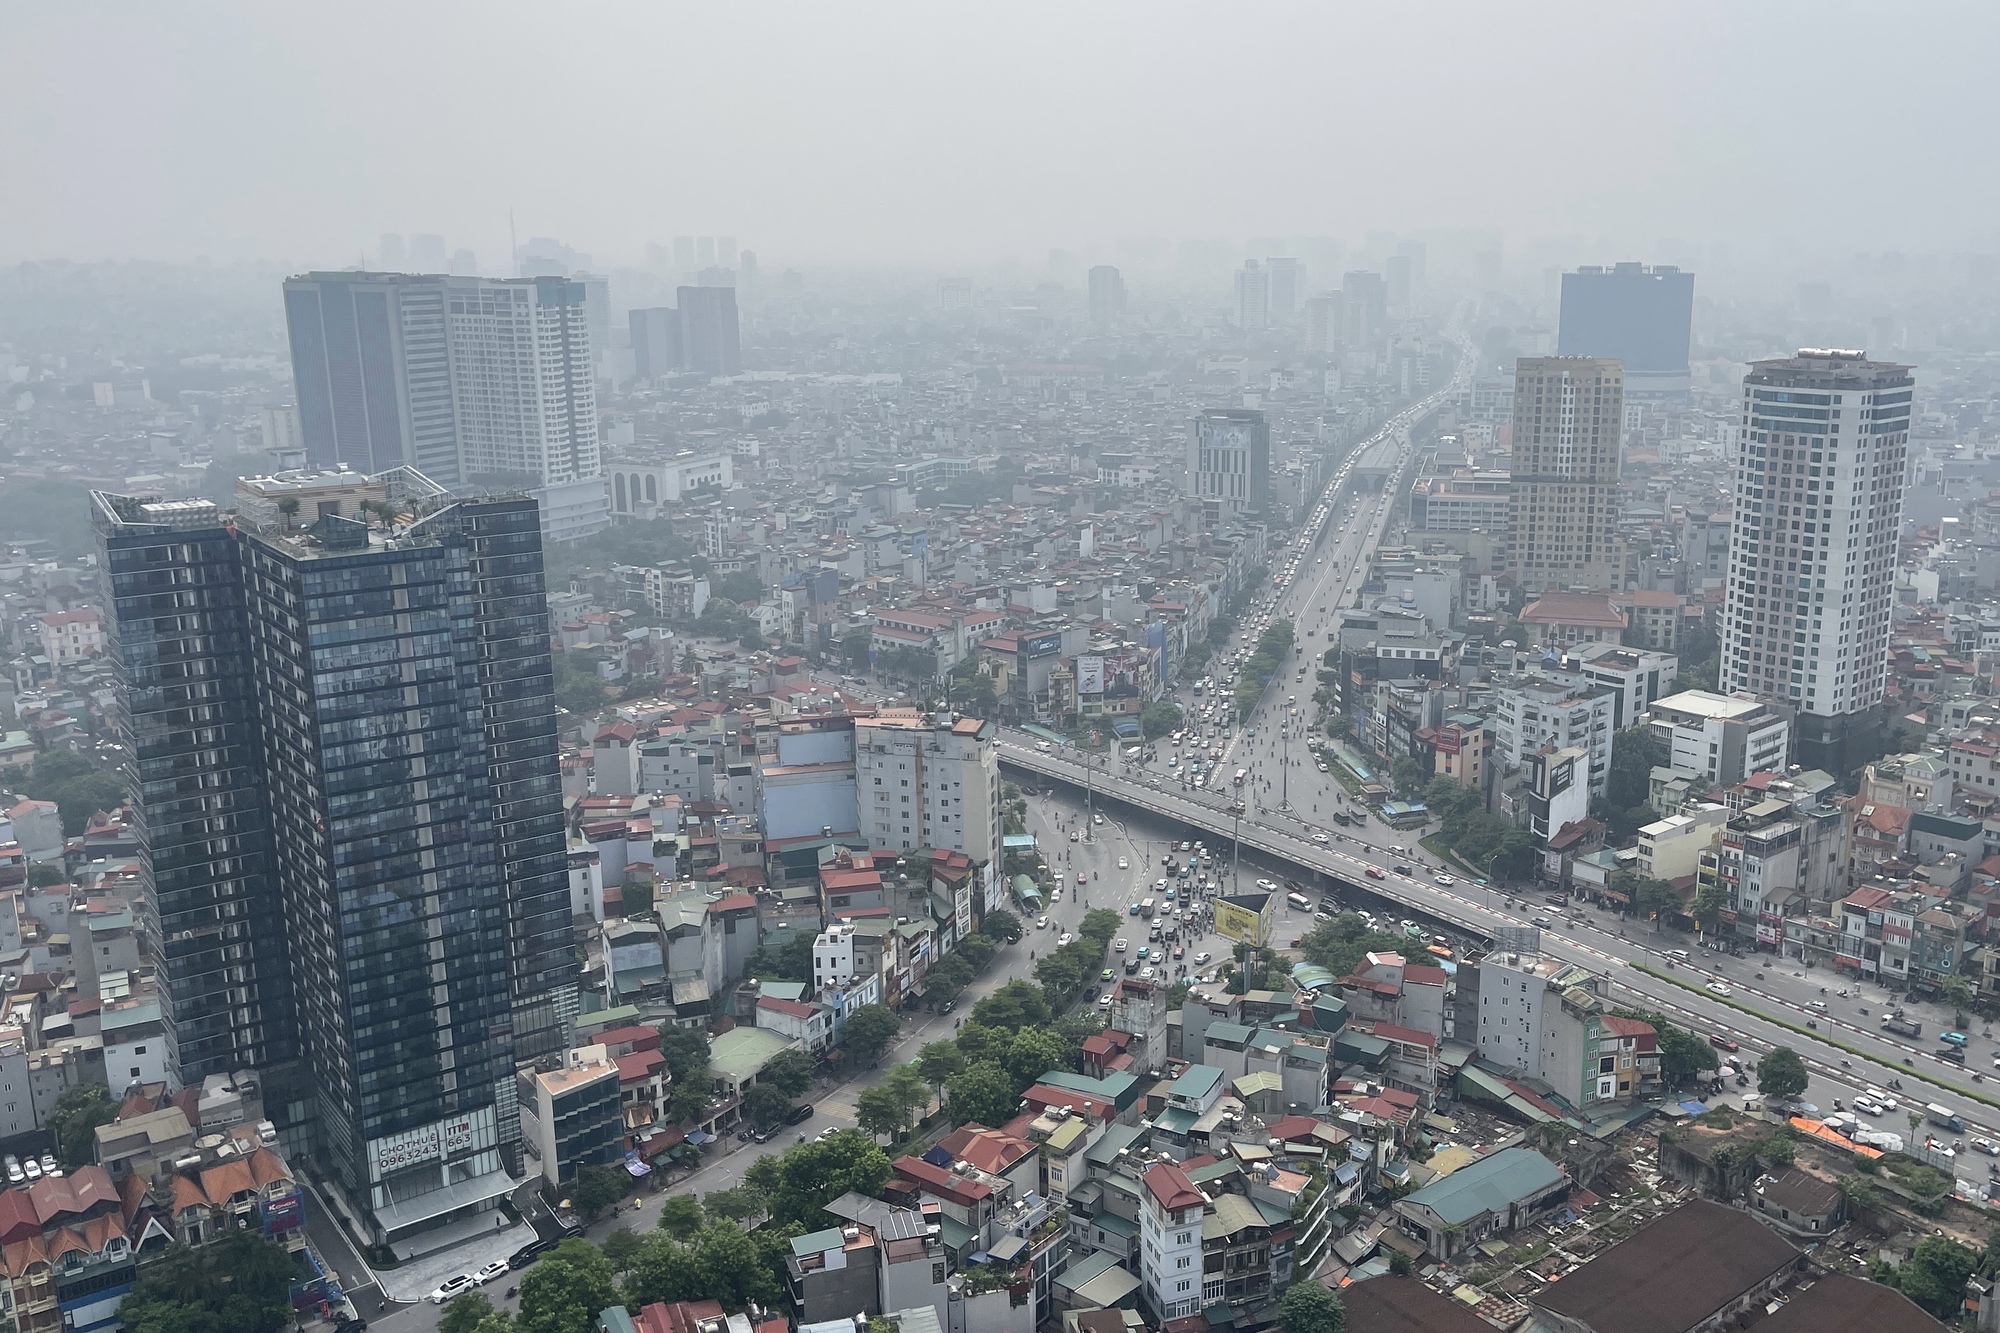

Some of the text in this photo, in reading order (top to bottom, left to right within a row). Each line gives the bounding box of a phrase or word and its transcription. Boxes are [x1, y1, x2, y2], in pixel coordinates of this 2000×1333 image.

[447, 1122, 469, 1136] TTTM
[380, 1134, 471, 1168] 0963243 663
